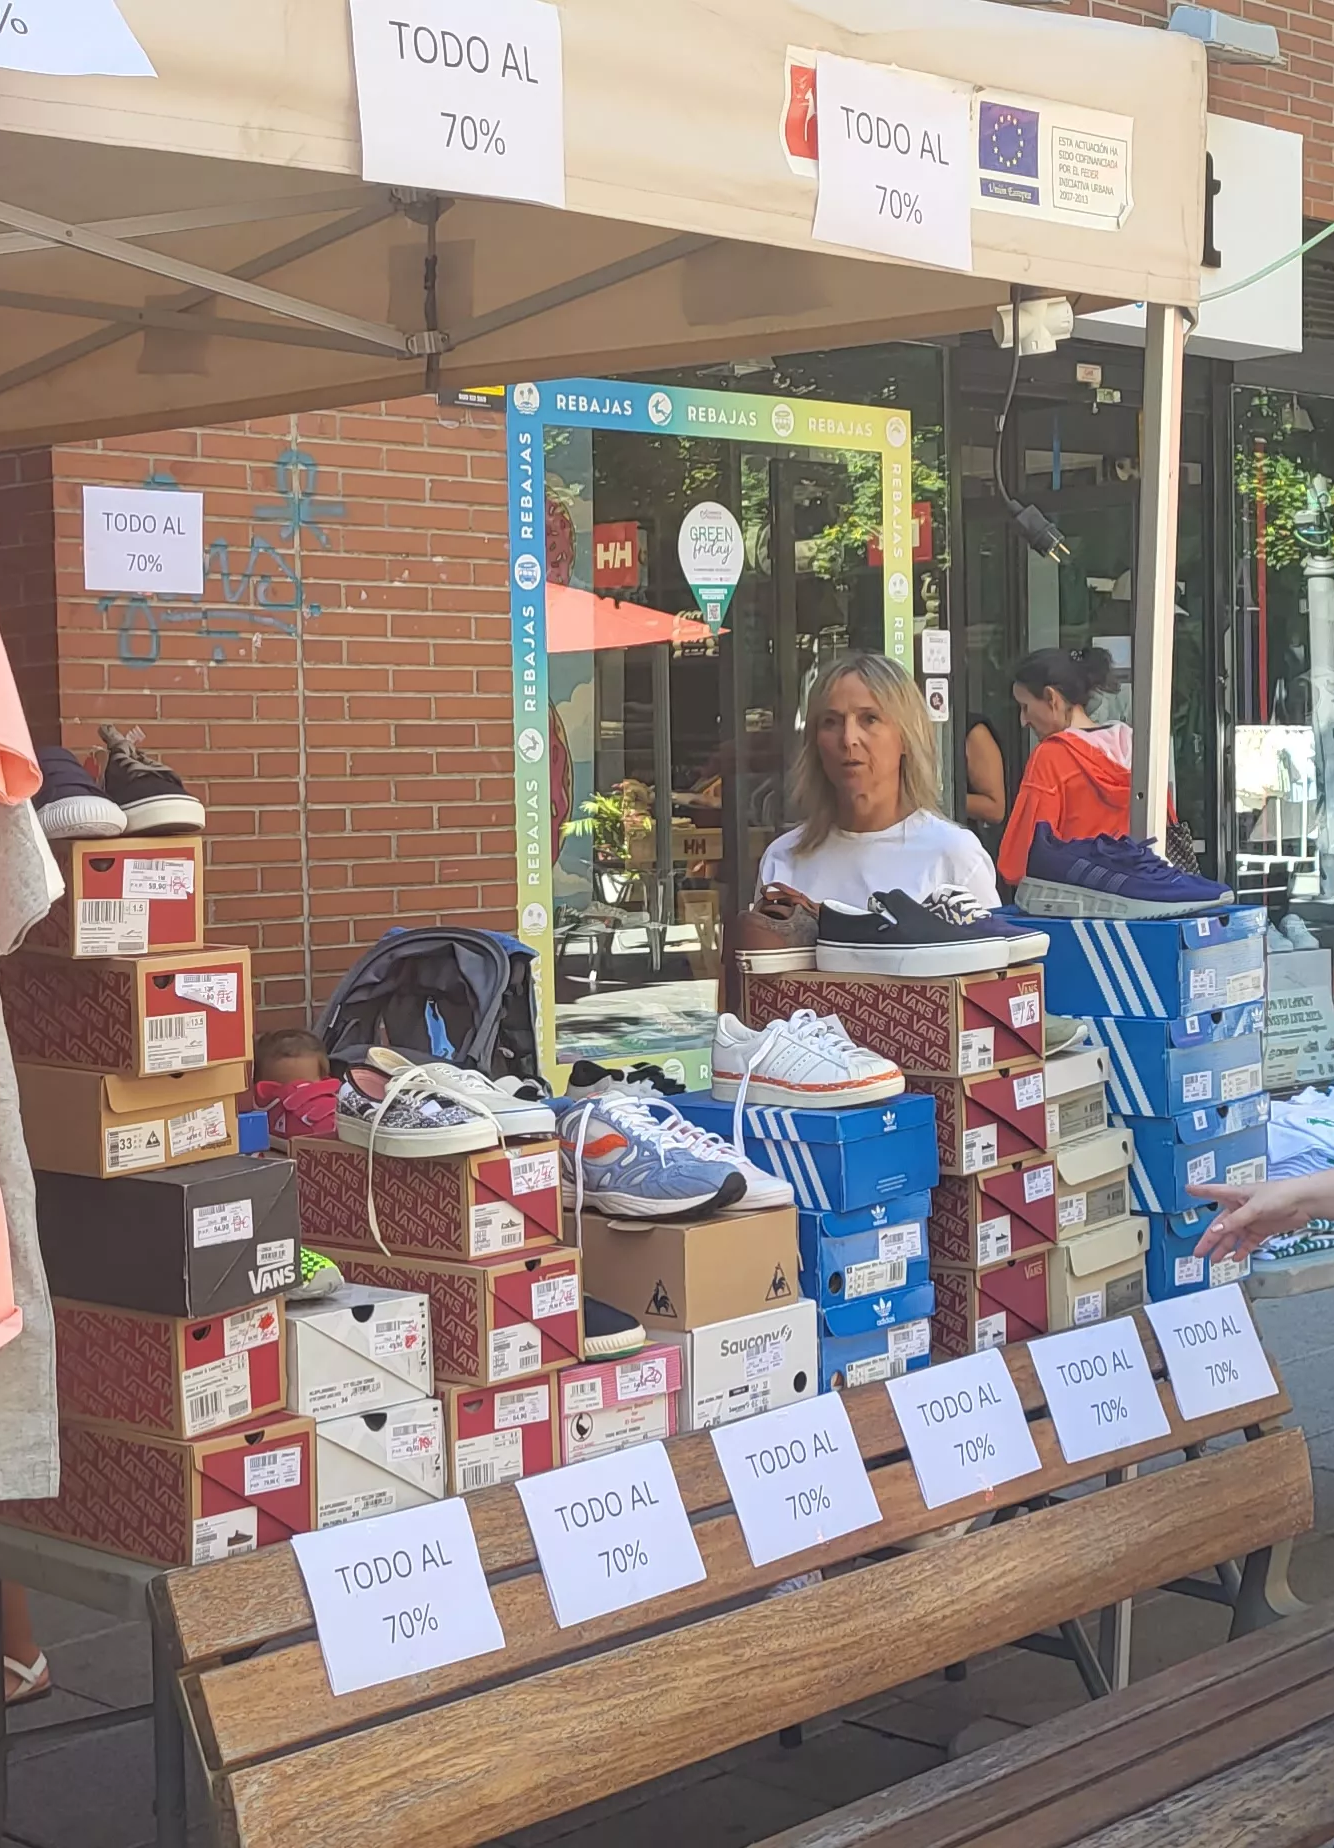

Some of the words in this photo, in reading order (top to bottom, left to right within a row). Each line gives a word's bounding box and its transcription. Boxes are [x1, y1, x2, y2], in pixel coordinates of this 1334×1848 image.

[388, 20, 490, 74] TODO
[501, 42, 539, 85] AL
[440, 111, 506, 156] 70%
[840, 105, 911, 155] TODO
[919, 130, 950, 166] AL
[1058, 137, 1073, 148] ESTA
[1075, 141, 1108, 155] ACTUACIÓN
[1109, 147, 1118, 157] HA
[1058, 150, 1074, 162] SIDO
[1058, 163, 1072, 174] POR
[1072, 166, 1080, 177] EL
[1080, 168, 1099, 180] FEDER
[1059, 176, 1090, 191] INICIATIVA
[1091, 183, 1114, 196] URBANA
[1059, 190, 1089, 205] 2007-2013
[875, 184, 923, 225] 70%
[556, 393, 633, 417] REBAJAS
[687, 405, 758, 427] REBAJAS
[808, 417, 873, 438] REBAJAS
[520, 432, 533, 540] REBAJAS
[101, 511, 157, 534] TODO
[162, 516, 186, 536] AL
[891, 463, 903, 559] REBAJAS
[689, 526, 734, 543] GREEN
[692, 537, 734, 565] friday
[126, 553, 163, 573] 70%
[596, 540, 632, 570] HH
[524, 604, 537, 712] REBAJAS
[526, 779, 540, 886] REBAJAS
[684, 839, 706, 856] HH
[822, 982, 851, 1010] VANS
[903, 988, 934, 1018] VANS
[1017, 979, 1039, 994] VANS
[855, 1001, 888, 1031] VANS
[879, 995, 911, 1024] VANS
[866, 1027, 898, 1058] VANS
[890, 1021, 923, 1051] VANS
[914, 1015, 946, 1045] VANS
[119, 1138, 132, 1151] 33
[311, 1160, 340, 1195] VANS
[333, 1155, 362, 1189] VANS
[408, 1166, 437, 1201] VANS
[321, 1190, 350, 1225] VANS
[385, 1173, 415, 1208] VANS
[395, 1204, 426, 1239] VANS
[418, 1198, 448, 1233] VANS
[248, 1262, 296, 1295] VANS
[1023, 1260, 1044, 1281] VANS
[431, 1276, 464, 1313] VANS
[442, 1308, 475, 1346] VANS
[720, 1329, 780, 1357] Saucony
[1172, 1320, 1218, 1349] TODO
[1221, 1315, 1242, 1338] AL
[136, 1328, 170, 1368] VANS
[1056, 1355, 1108, 1387] TODO
[1112, 1348, 1134, 1373] AL
[1204, 1359, 1239, 1387] 70%
[123, 1368, 156, 1407] VANS
[916, 1390, 973, 1427] TODO
[978, 1382, 1002, 1409] AL
[1090, 1396, 1128, 1426] 70%
[744, 1439, 807, 1478] TODO
[813, 1430, 839, 1458] AL
[953, 1433, 996, 1467] 70%
[554, 1491, 623, 1532] TODO
[631, 1480, 660, 1511] AL
[784, 1484, 831, 1521] 70%
[334, 1550, 412, 1594] TODO
[422, 1539, 453, 1572] AL
[597, 1539, 649, 1578] 70%
[382, 1603, 439, 1644] 70%
